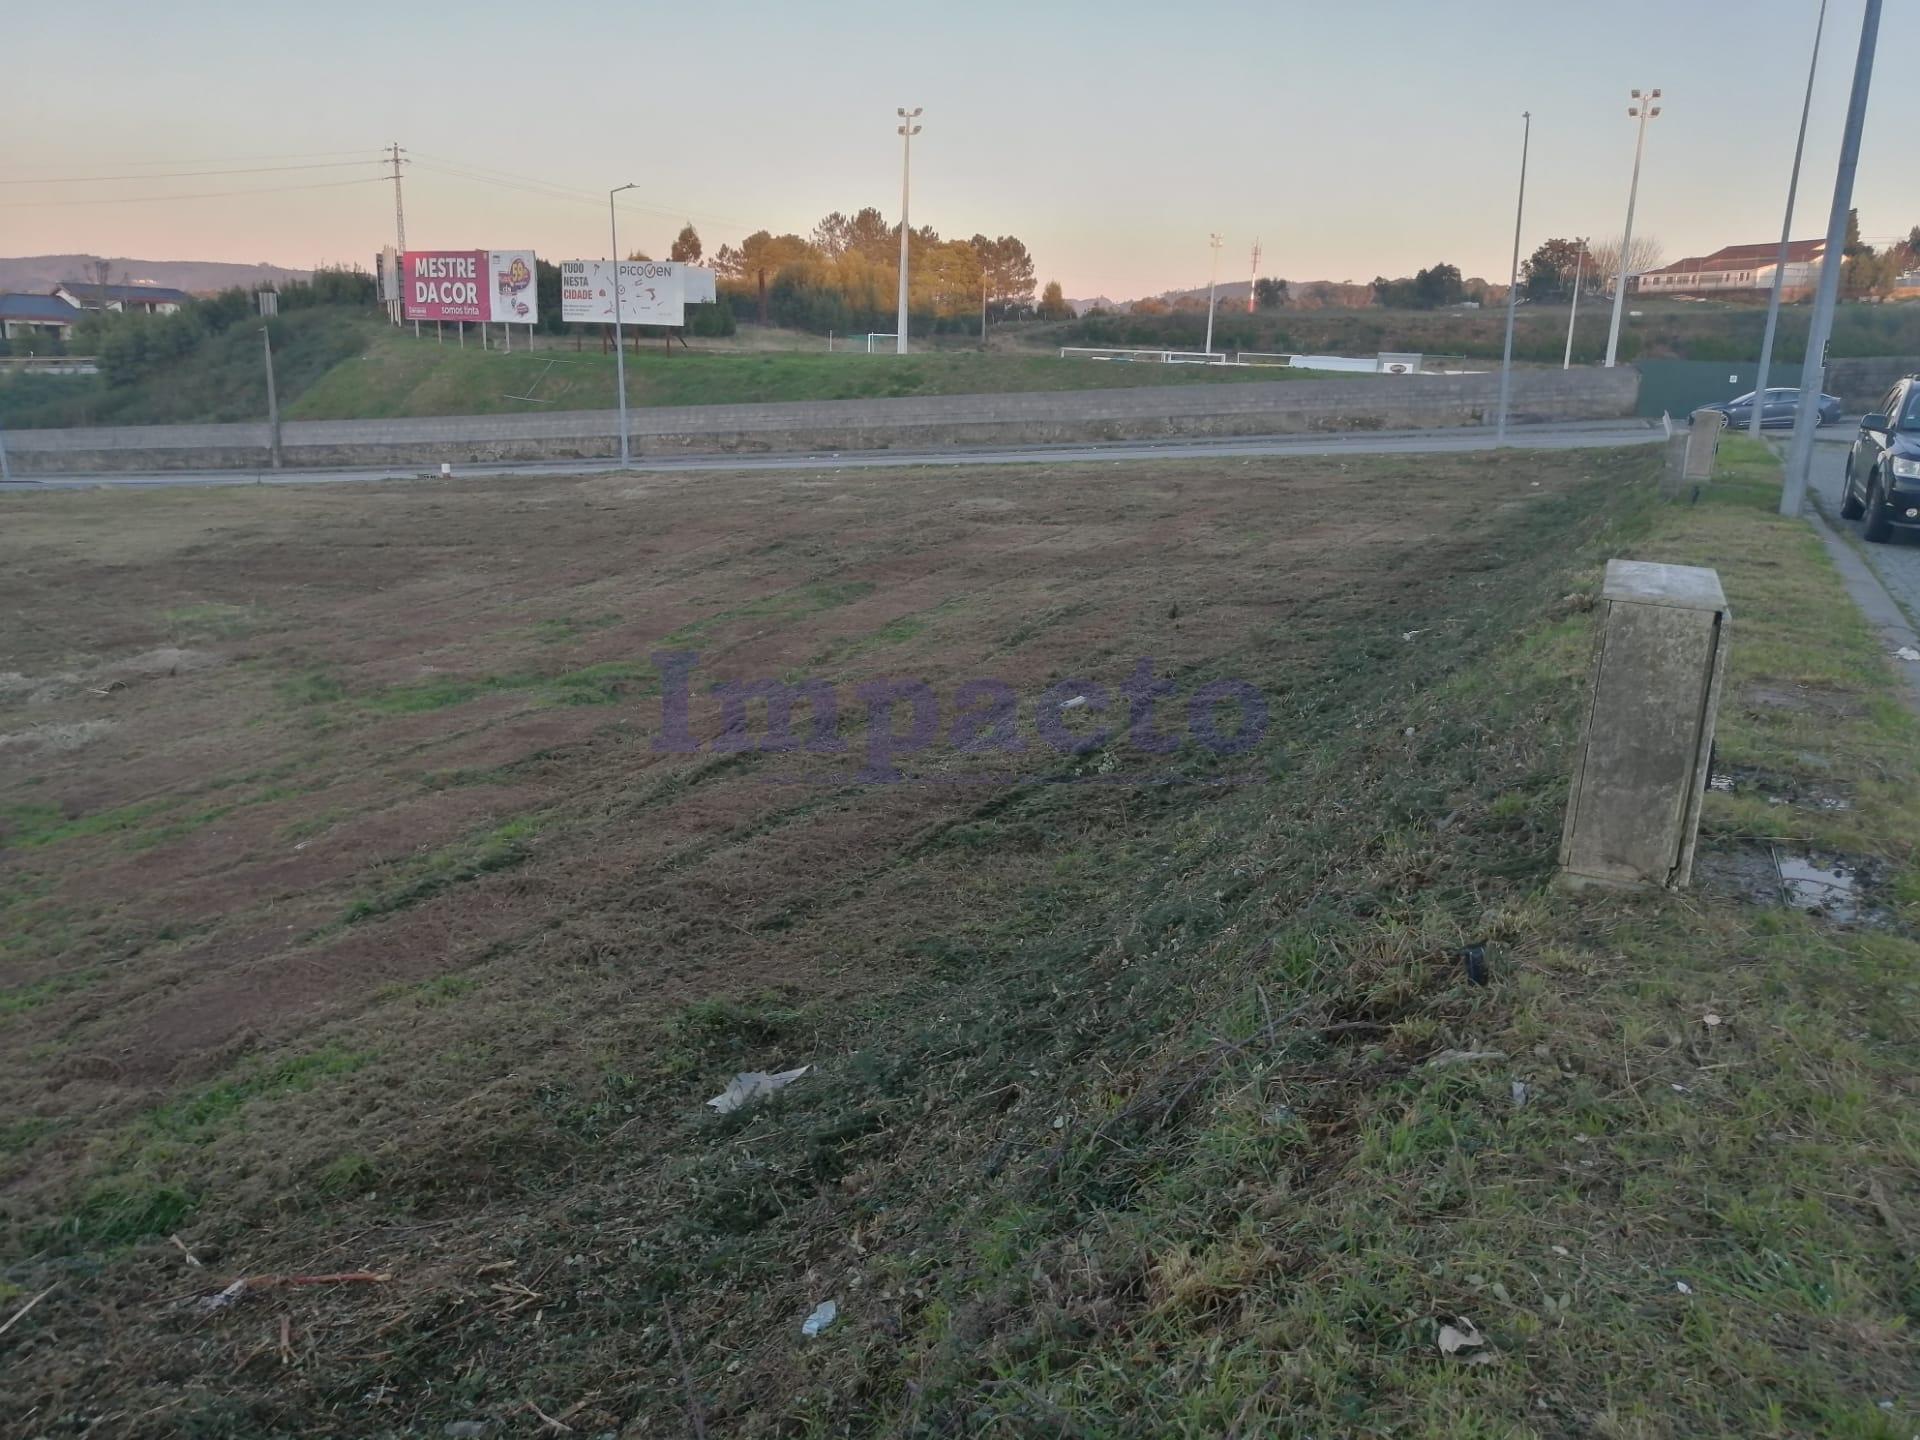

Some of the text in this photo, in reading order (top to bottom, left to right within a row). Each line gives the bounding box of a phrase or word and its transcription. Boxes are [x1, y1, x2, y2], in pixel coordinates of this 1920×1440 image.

[416, 257, 476, 278] MESTRE
[563, 263, 584, 273] TUDO
[563, 276, 589, 287] NESTA
[563, 290, 593, 300] CIDADE
[441, 306, 480, 315] somos tinta
